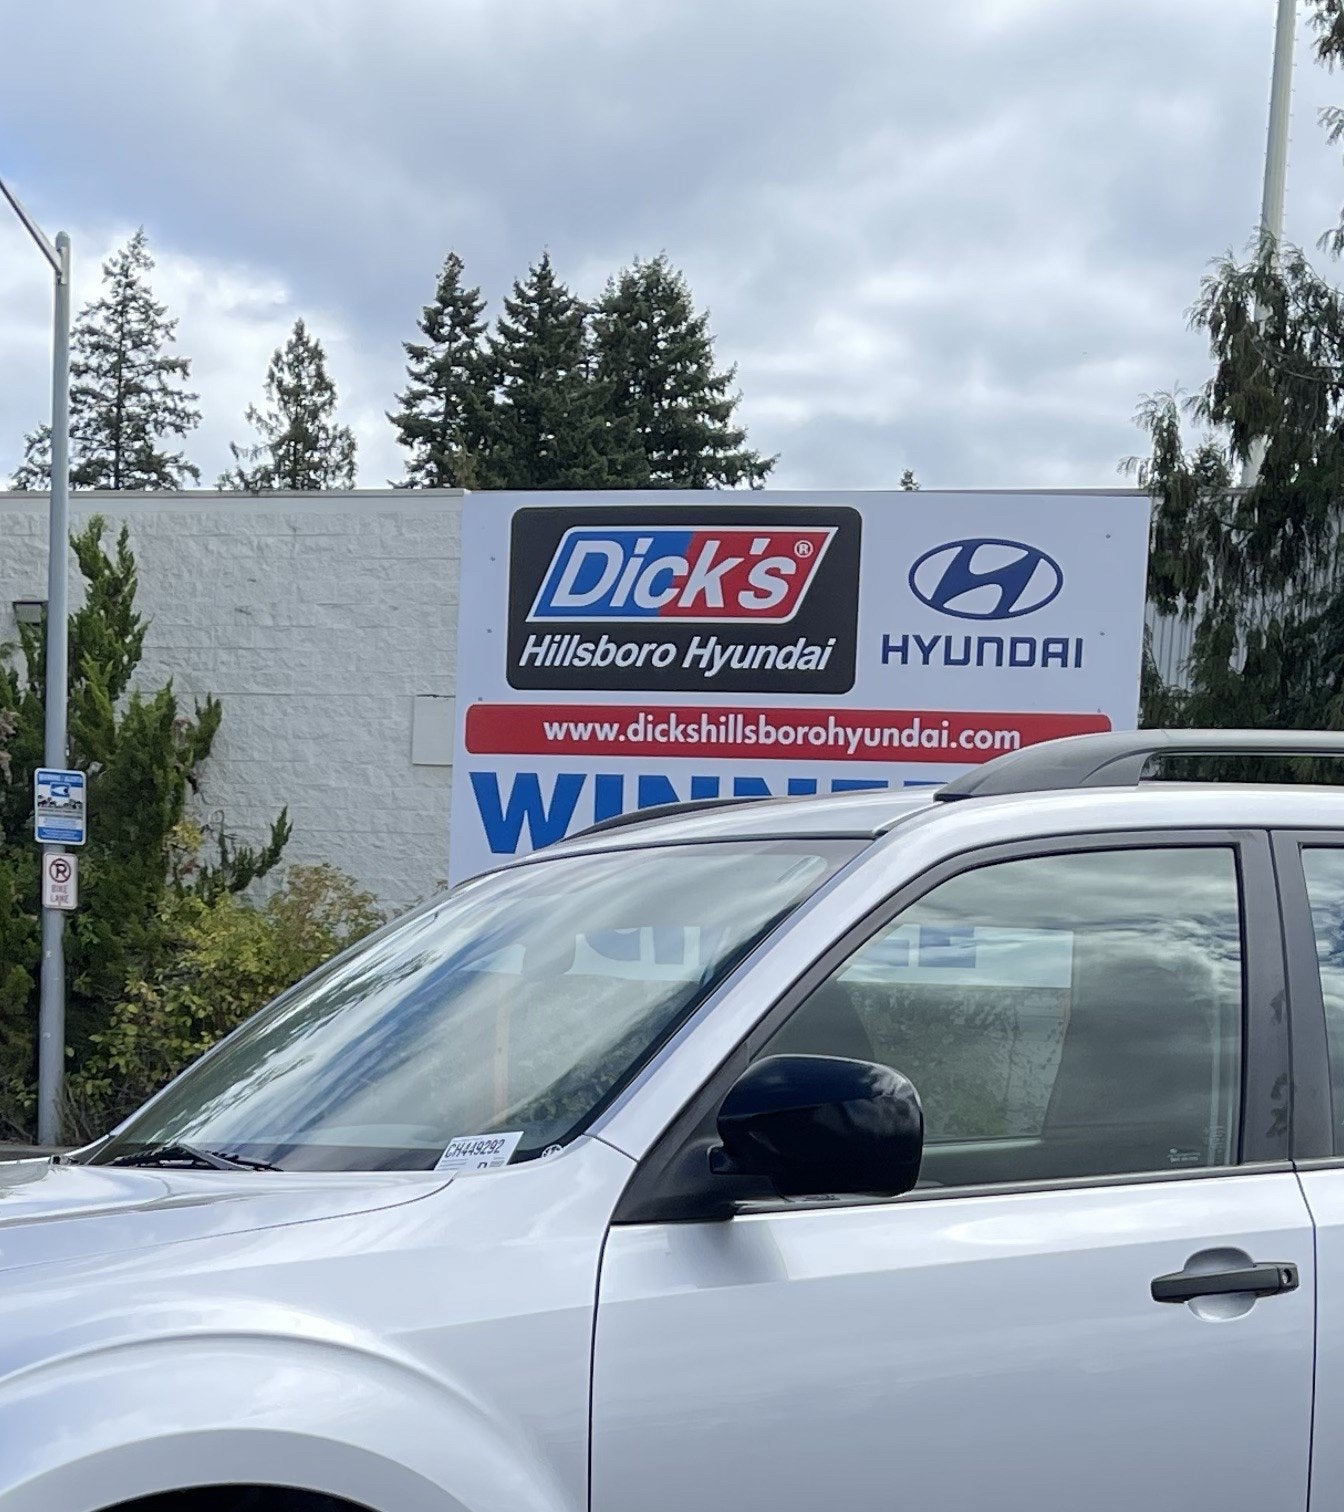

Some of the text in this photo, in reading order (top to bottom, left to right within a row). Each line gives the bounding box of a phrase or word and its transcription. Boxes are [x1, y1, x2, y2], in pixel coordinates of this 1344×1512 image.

[518, 634, 837, 678] Hillsboro Hyundai
[881, 633, 1084, 669] HYUNDAI
[543, 714, 1021, 755] www.dickshillsborohyundai.com
